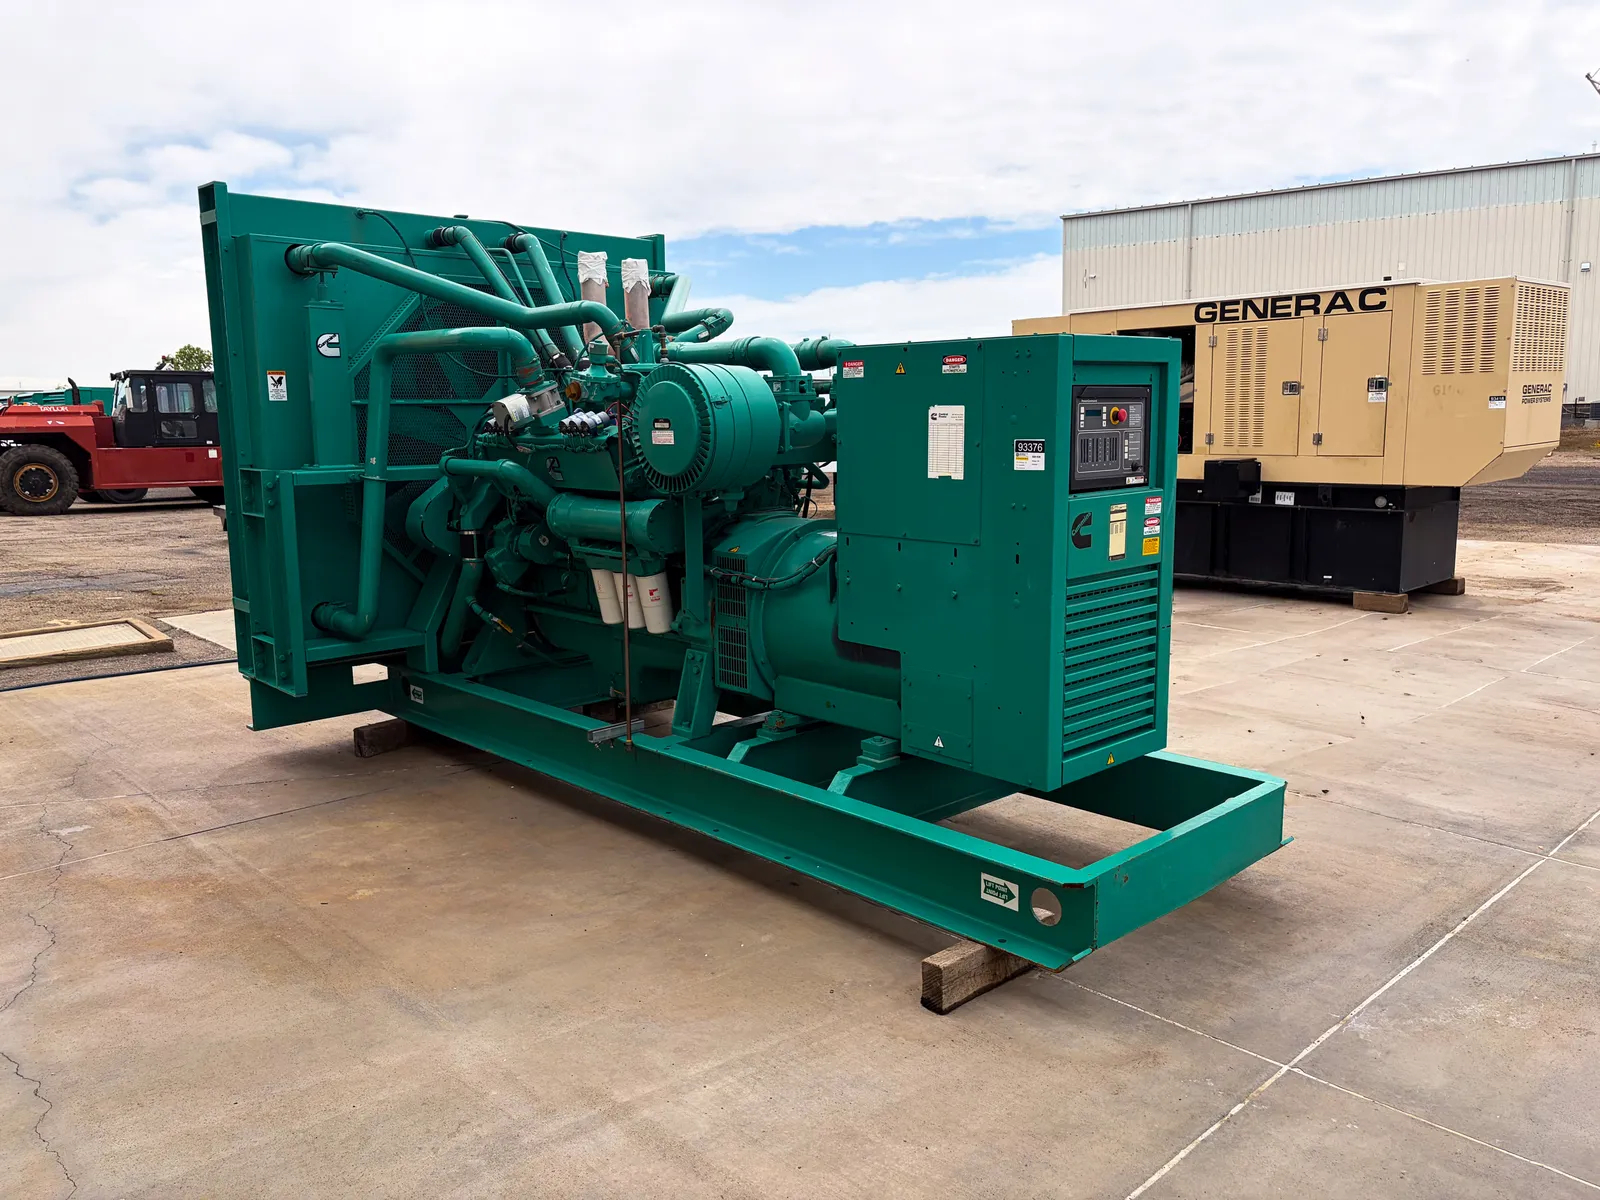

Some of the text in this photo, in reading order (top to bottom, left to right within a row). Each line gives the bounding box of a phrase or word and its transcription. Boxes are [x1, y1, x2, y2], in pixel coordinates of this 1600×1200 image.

[1194, 287, 1387, 323] GENERAC
[1522, 383, 1553, 394] GENERAC
[1521, 396, 1552, 405] POWER SYSTEMS
[1017, 442, 1043, 453] 93376
[1072, 512, 1092, 537] Cummins
[985, 888, 999, 896] POINT
[995, 884, 1008, 893] POINT
